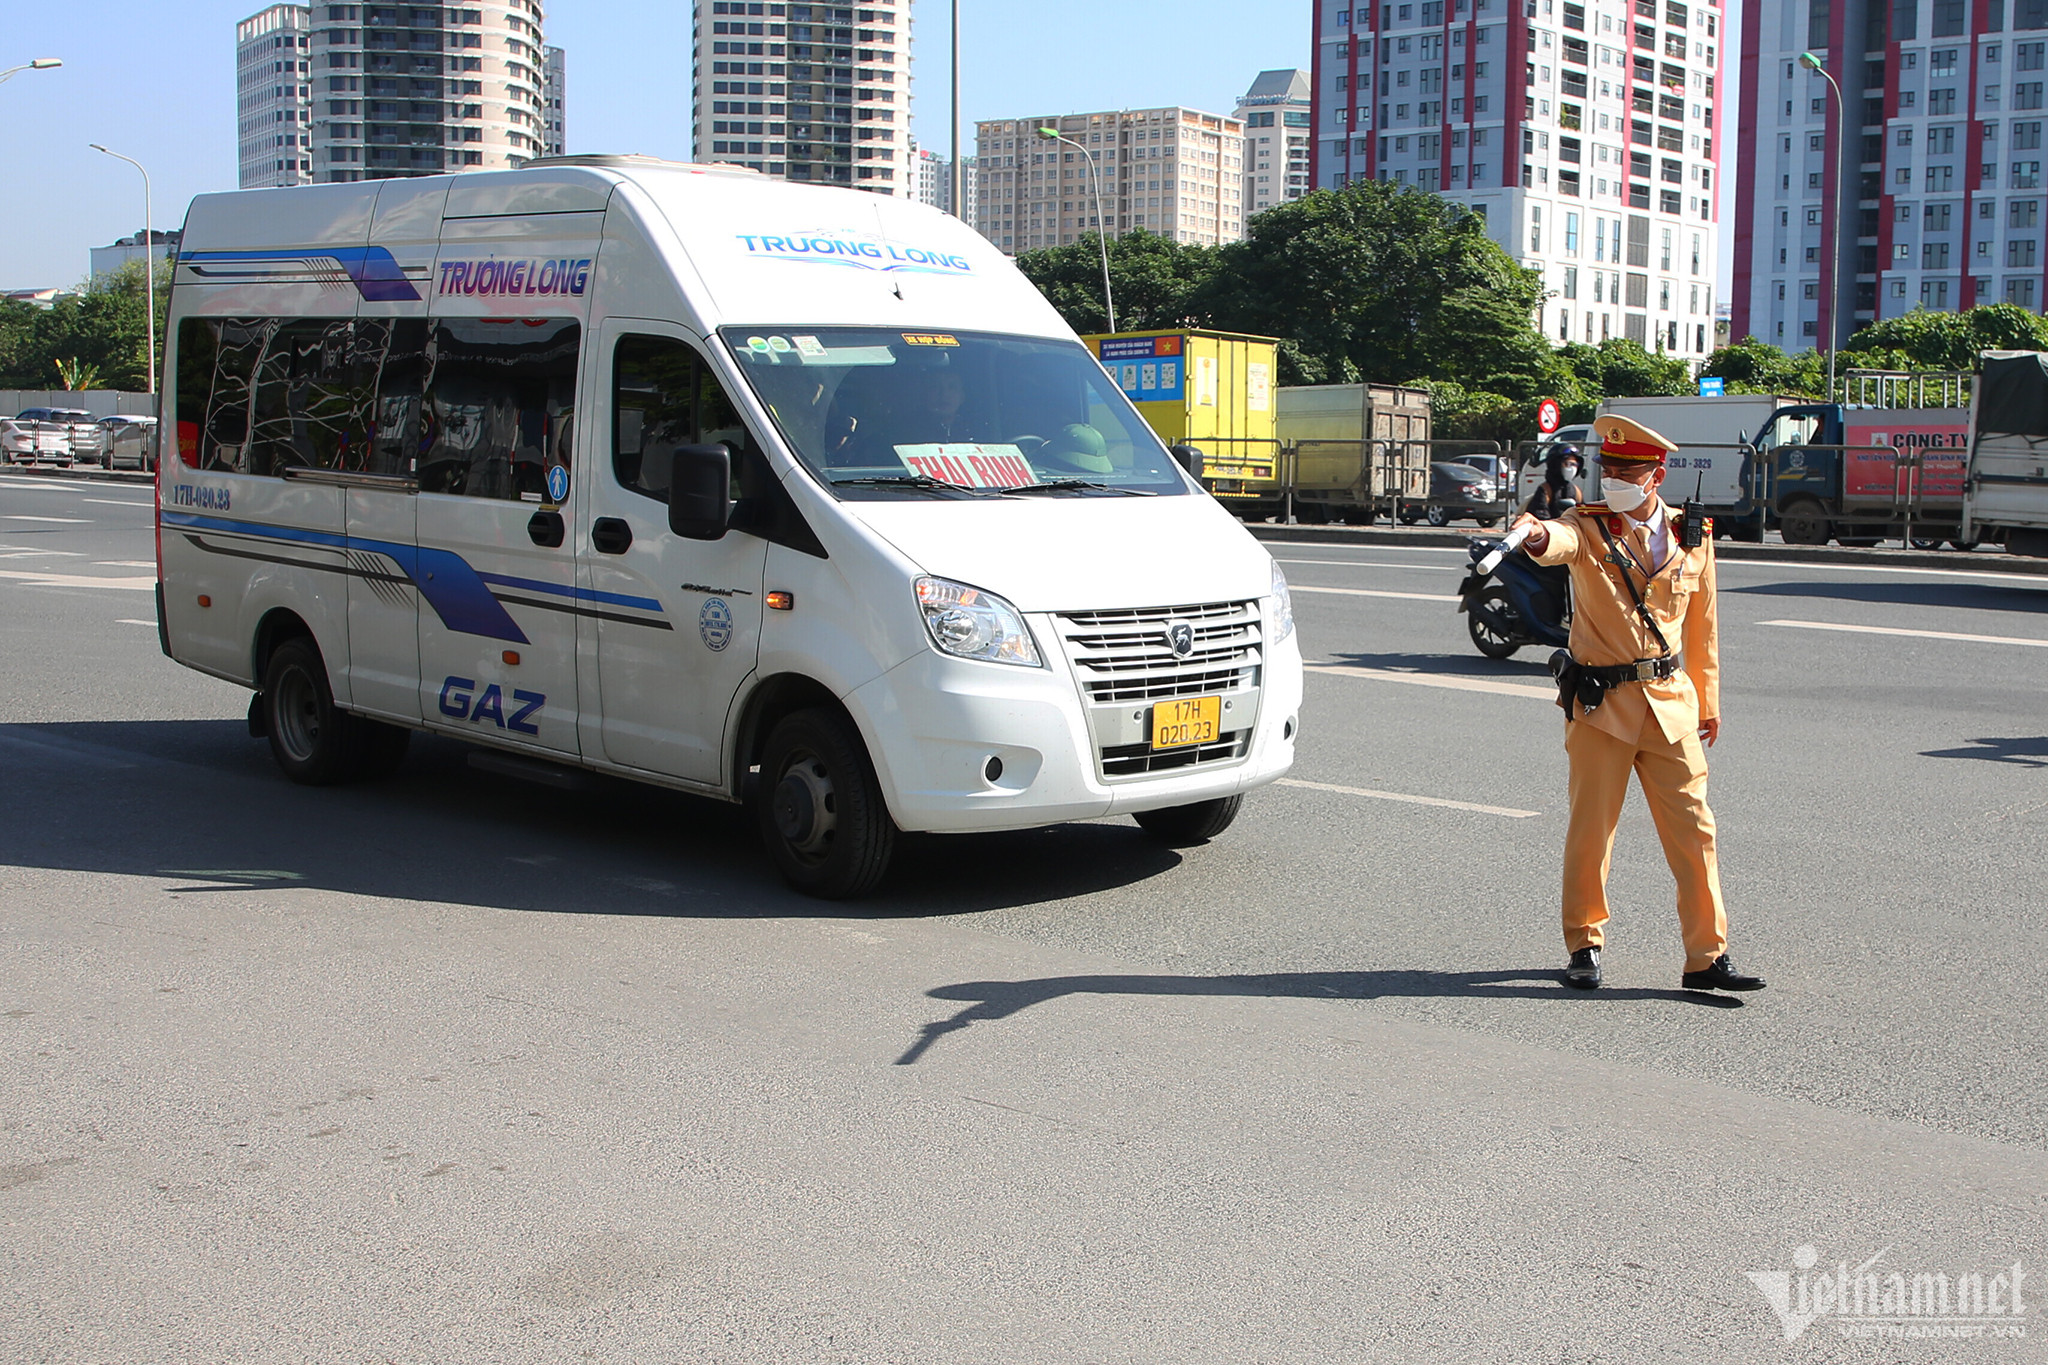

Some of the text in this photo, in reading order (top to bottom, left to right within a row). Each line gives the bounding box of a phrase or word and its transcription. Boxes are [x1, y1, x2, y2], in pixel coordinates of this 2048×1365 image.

[886, 245, 971, 271] LONG
[524, 259, 592, 295] LONG
[906, 447, 977, 488] THÁI
[439, 675, 547, 736] GAZ
[1174, 700, 1201, 721] 17H
[1160, 721, 1212, 745] 020.23
